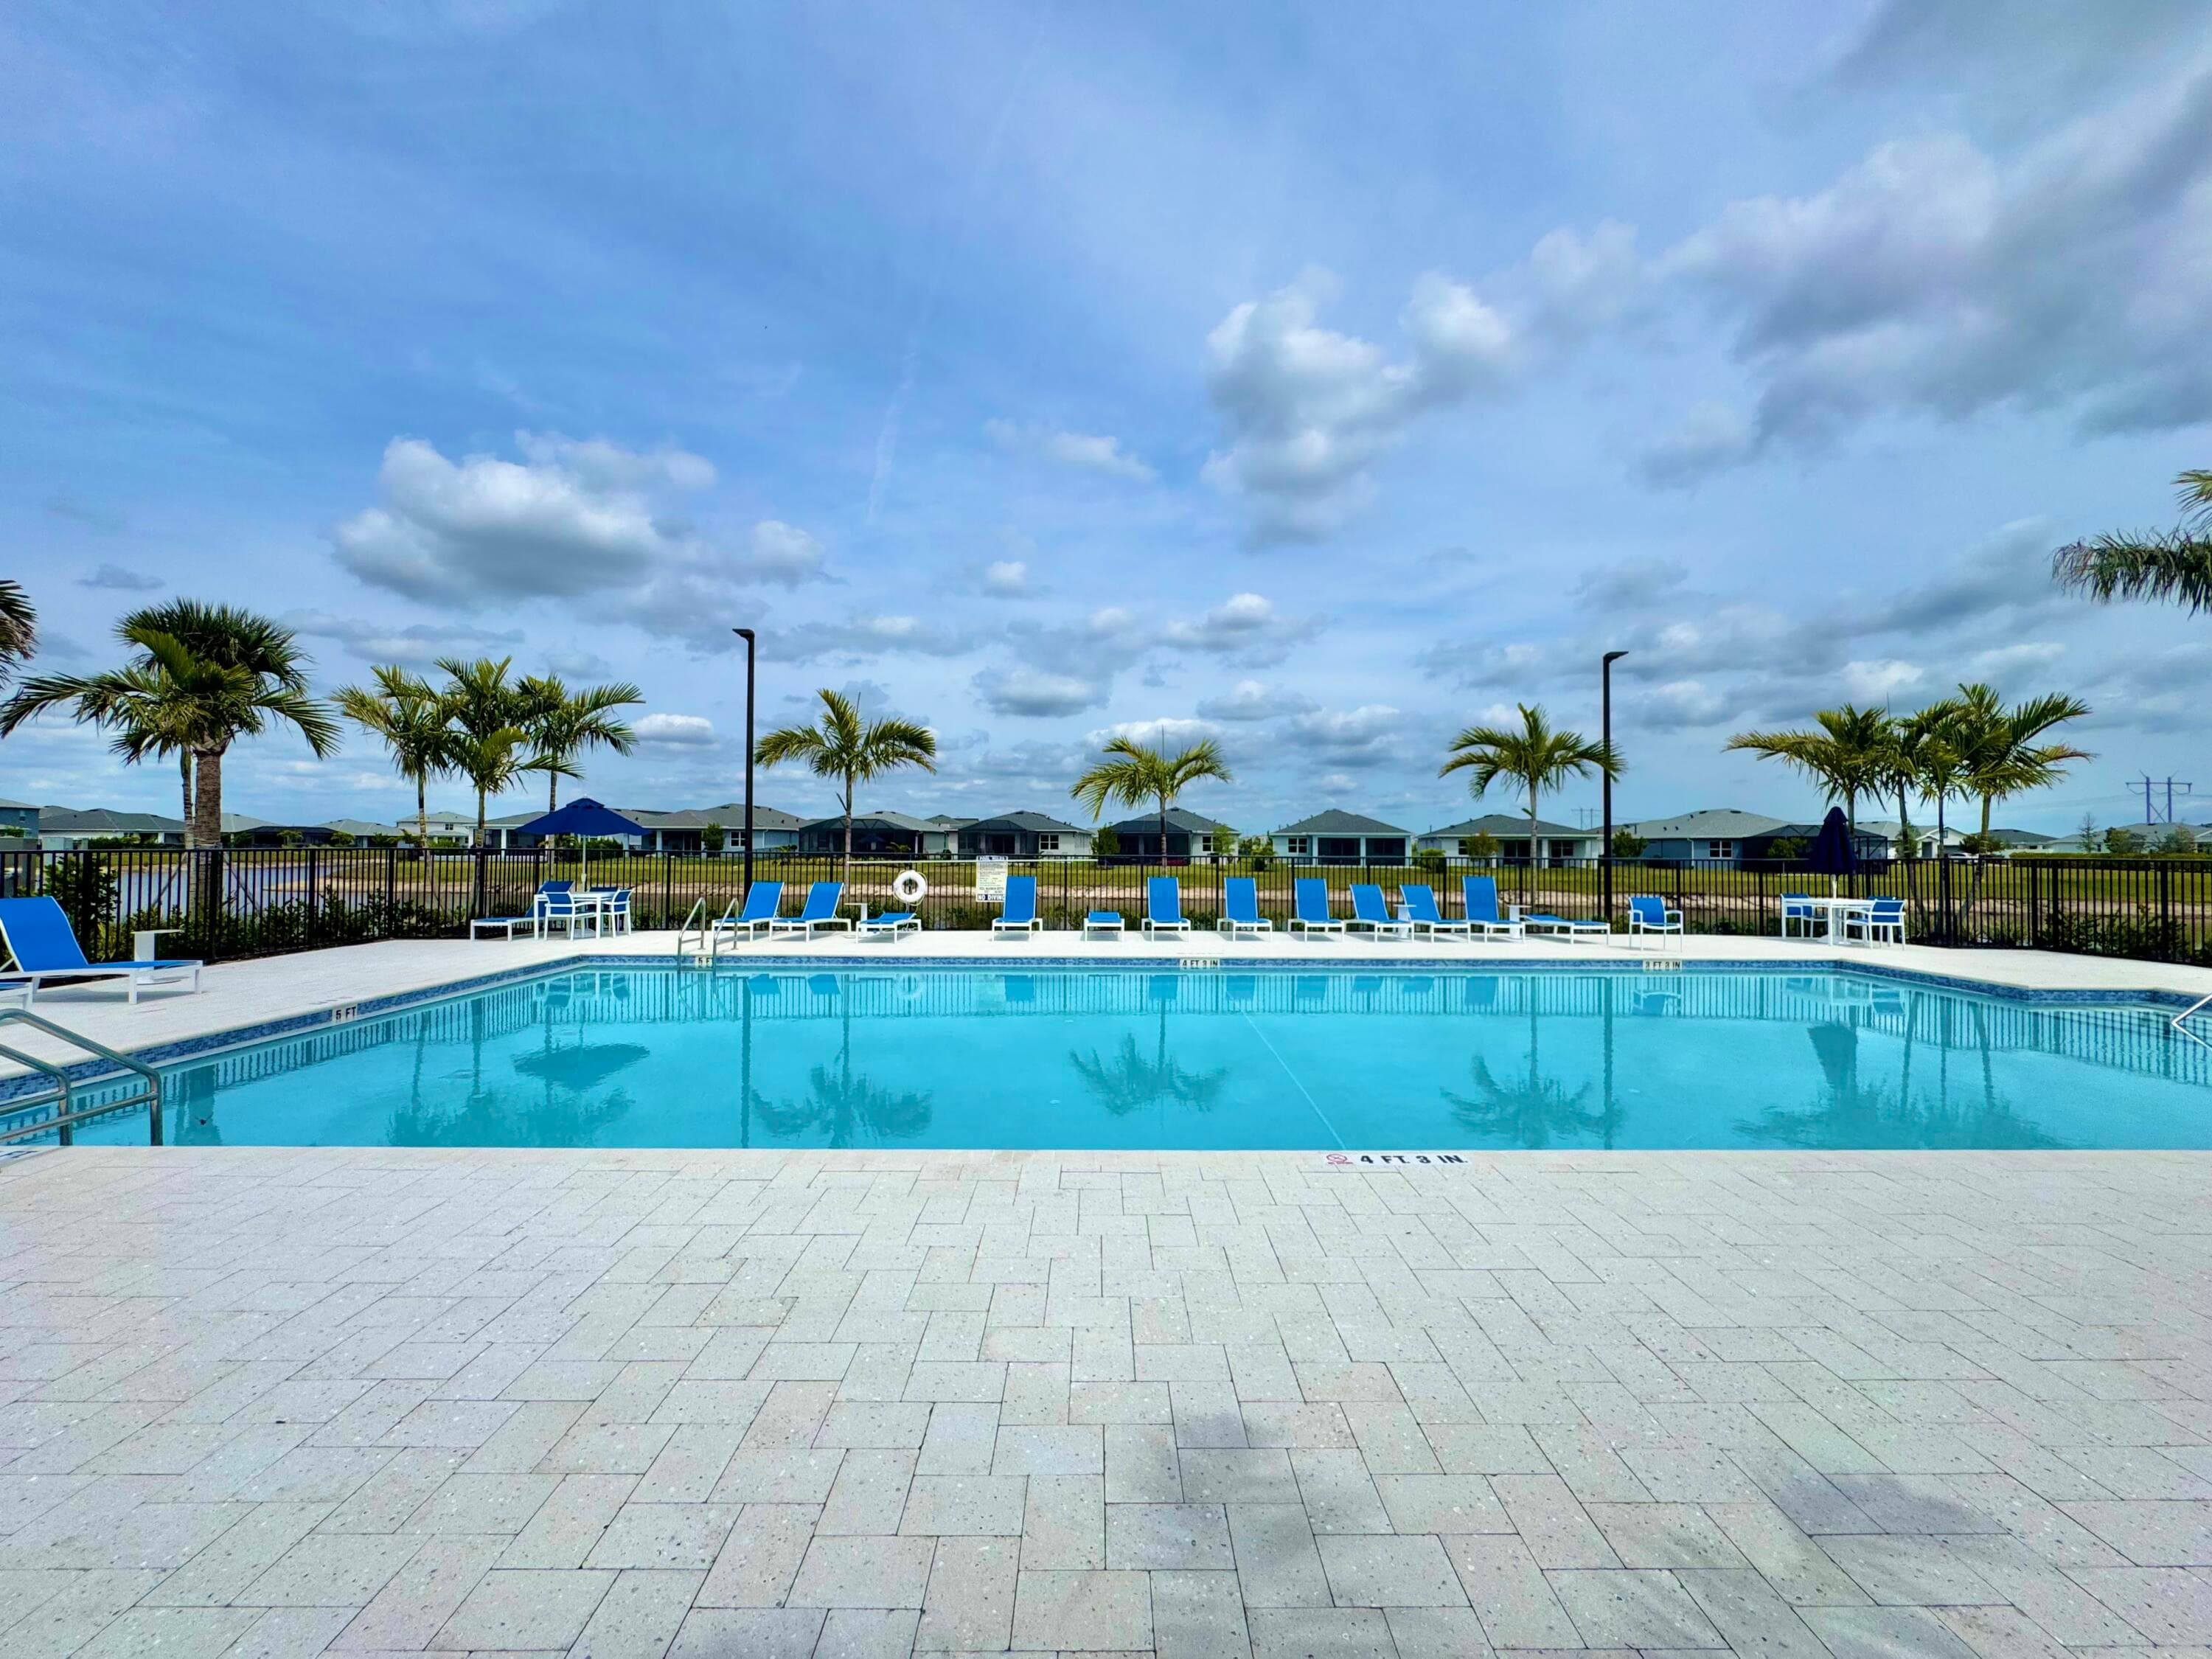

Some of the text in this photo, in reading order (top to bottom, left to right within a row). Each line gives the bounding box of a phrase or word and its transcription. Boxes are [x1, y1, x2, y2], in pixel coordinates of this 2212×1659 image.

[335, 1006, 356, 1021] 5 FT
[1360, 1155, 1468, 1164] 4 FT. 3 IN.
